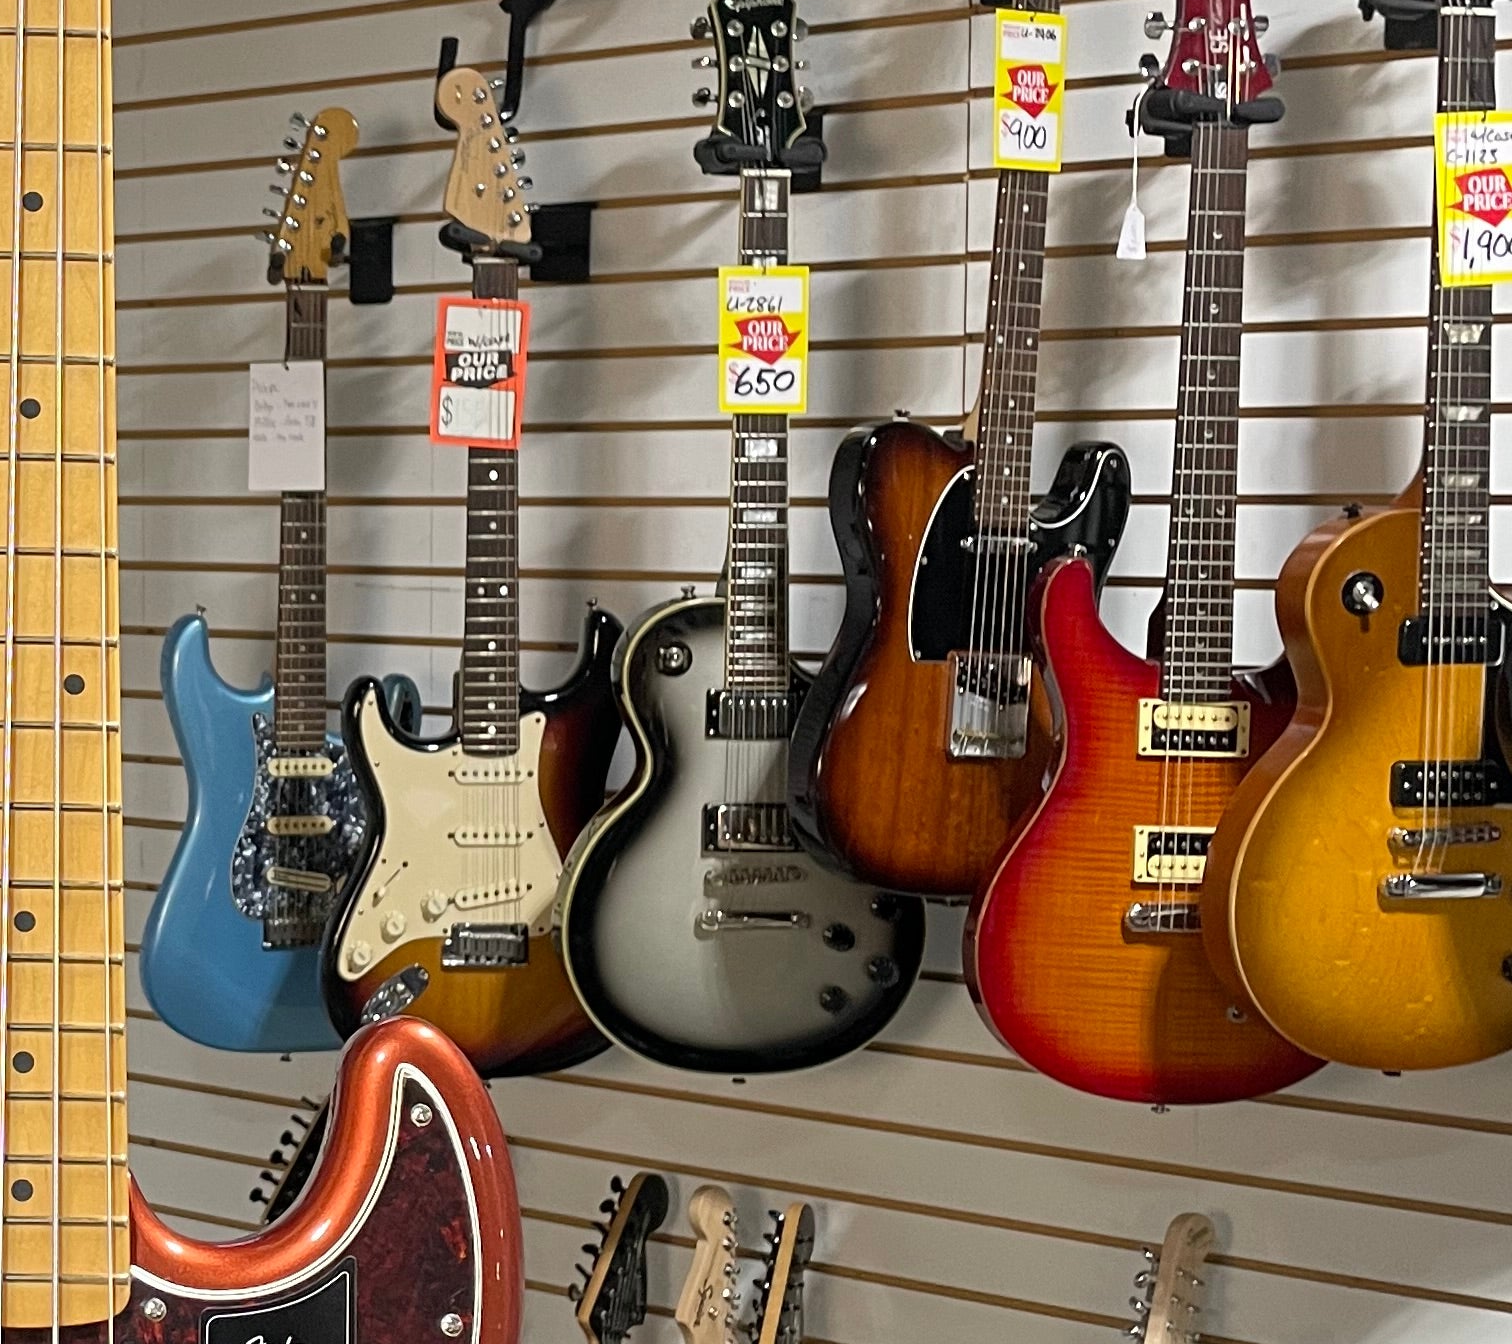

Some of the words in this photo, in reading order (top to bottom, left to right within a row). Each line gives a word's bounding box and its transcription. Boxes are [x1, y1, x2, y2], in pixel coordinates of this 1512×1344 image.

[1017, 69, 1045, 86] OUR
[1012, 84, 1050, 103] PRICE
[1467, 175, 1506, 194] OUR
[747, 320, 784, 337] OUR
[742, 335, 790, 353] PRICE
[457, 352, 500, 367] OUR
[450, 365, 508, 383] PRICE
